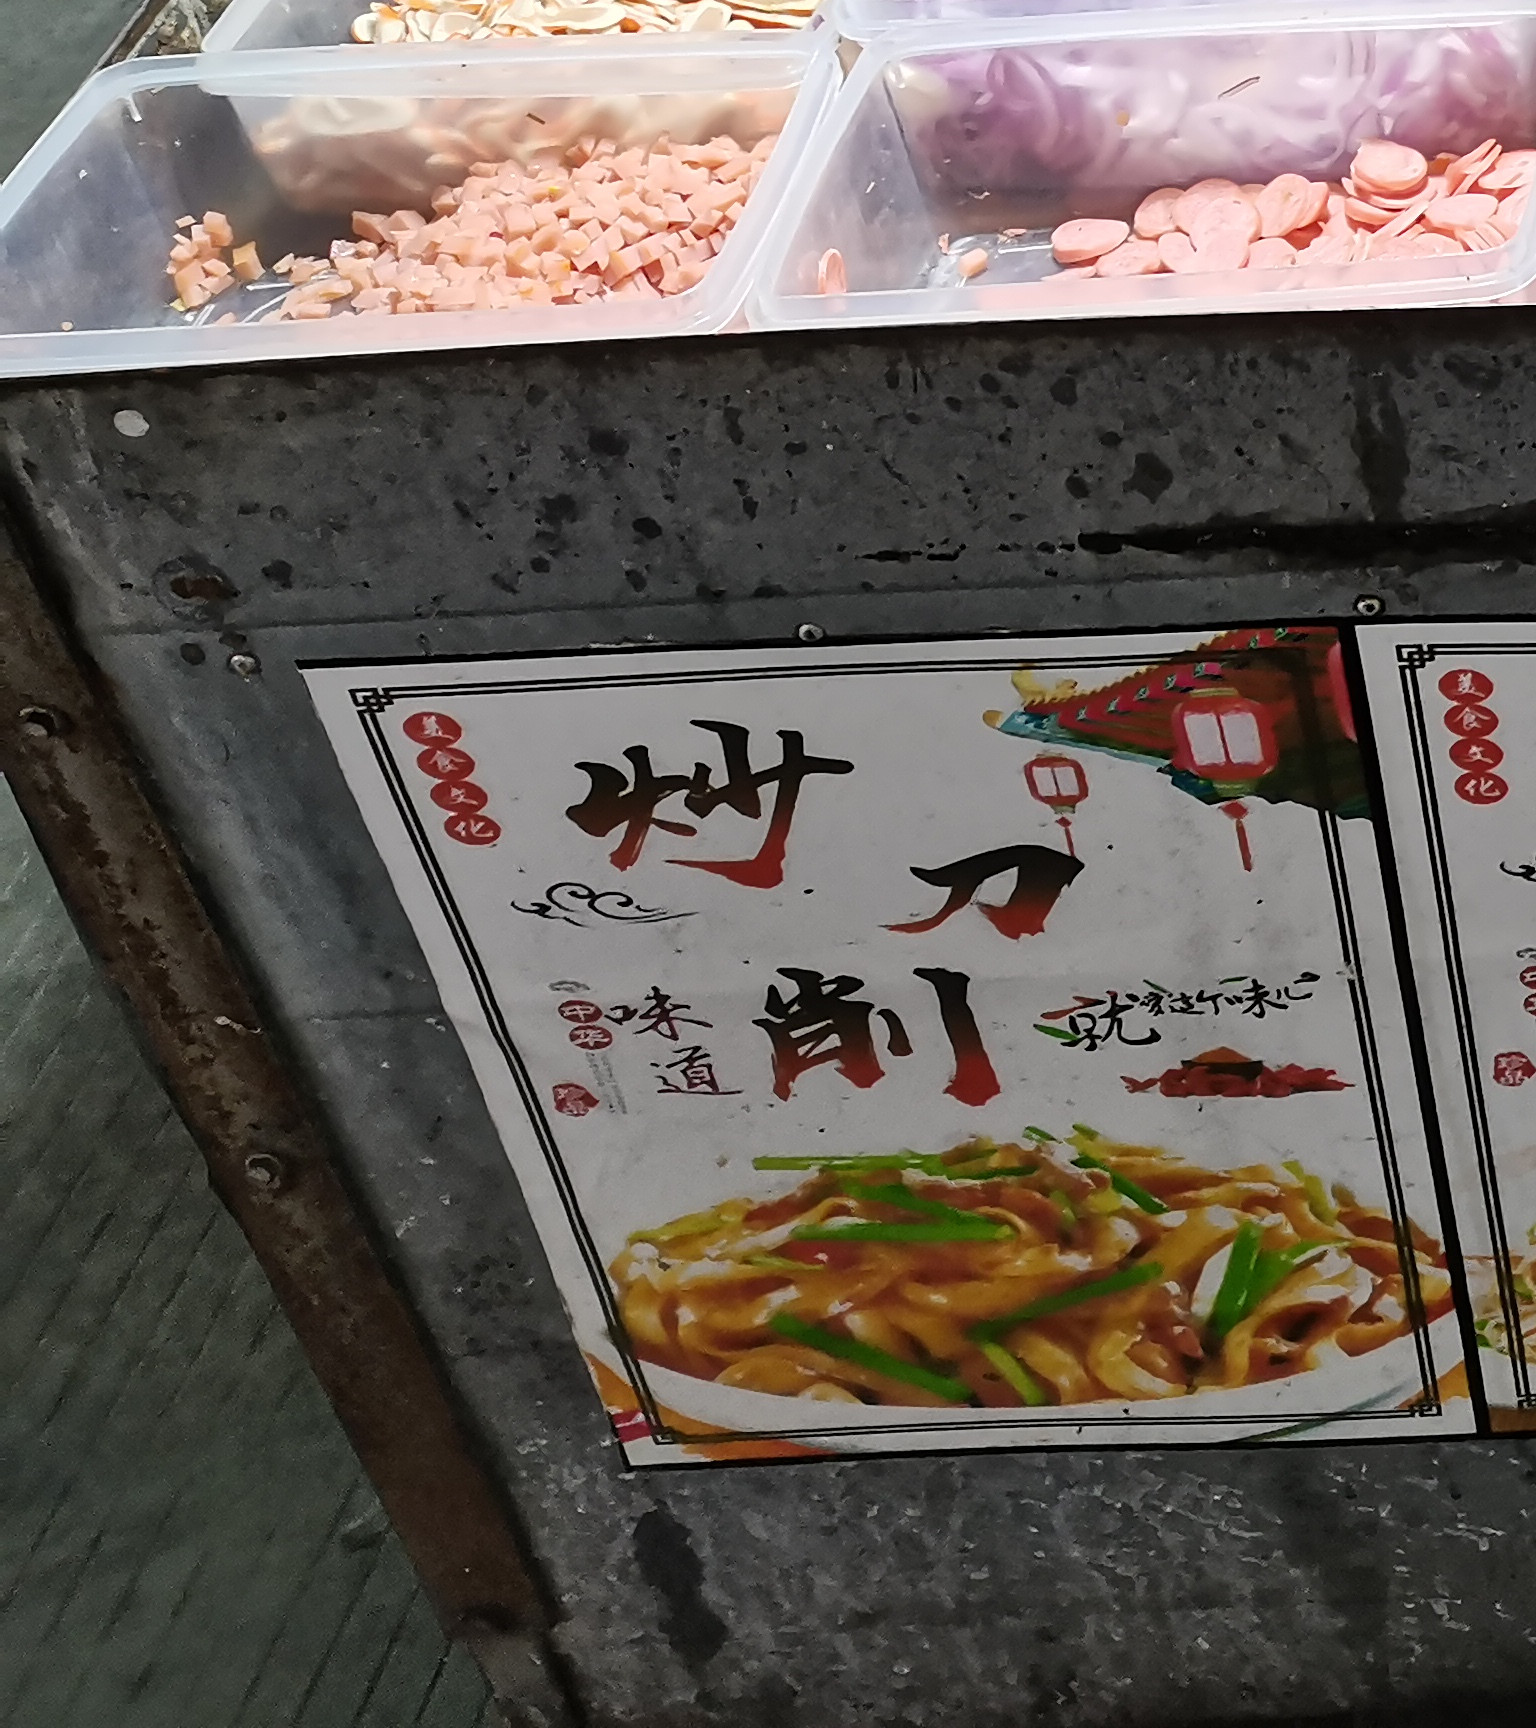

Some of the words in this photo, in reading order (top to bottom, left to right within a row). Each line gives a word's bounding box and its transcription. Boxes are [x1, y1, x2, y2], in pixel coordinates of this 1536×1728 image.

[415, 710, 499, 842] 美食文化
[1450, 670, 1505, 800] 美食文化
[566, 719, 855, 889] 炒
